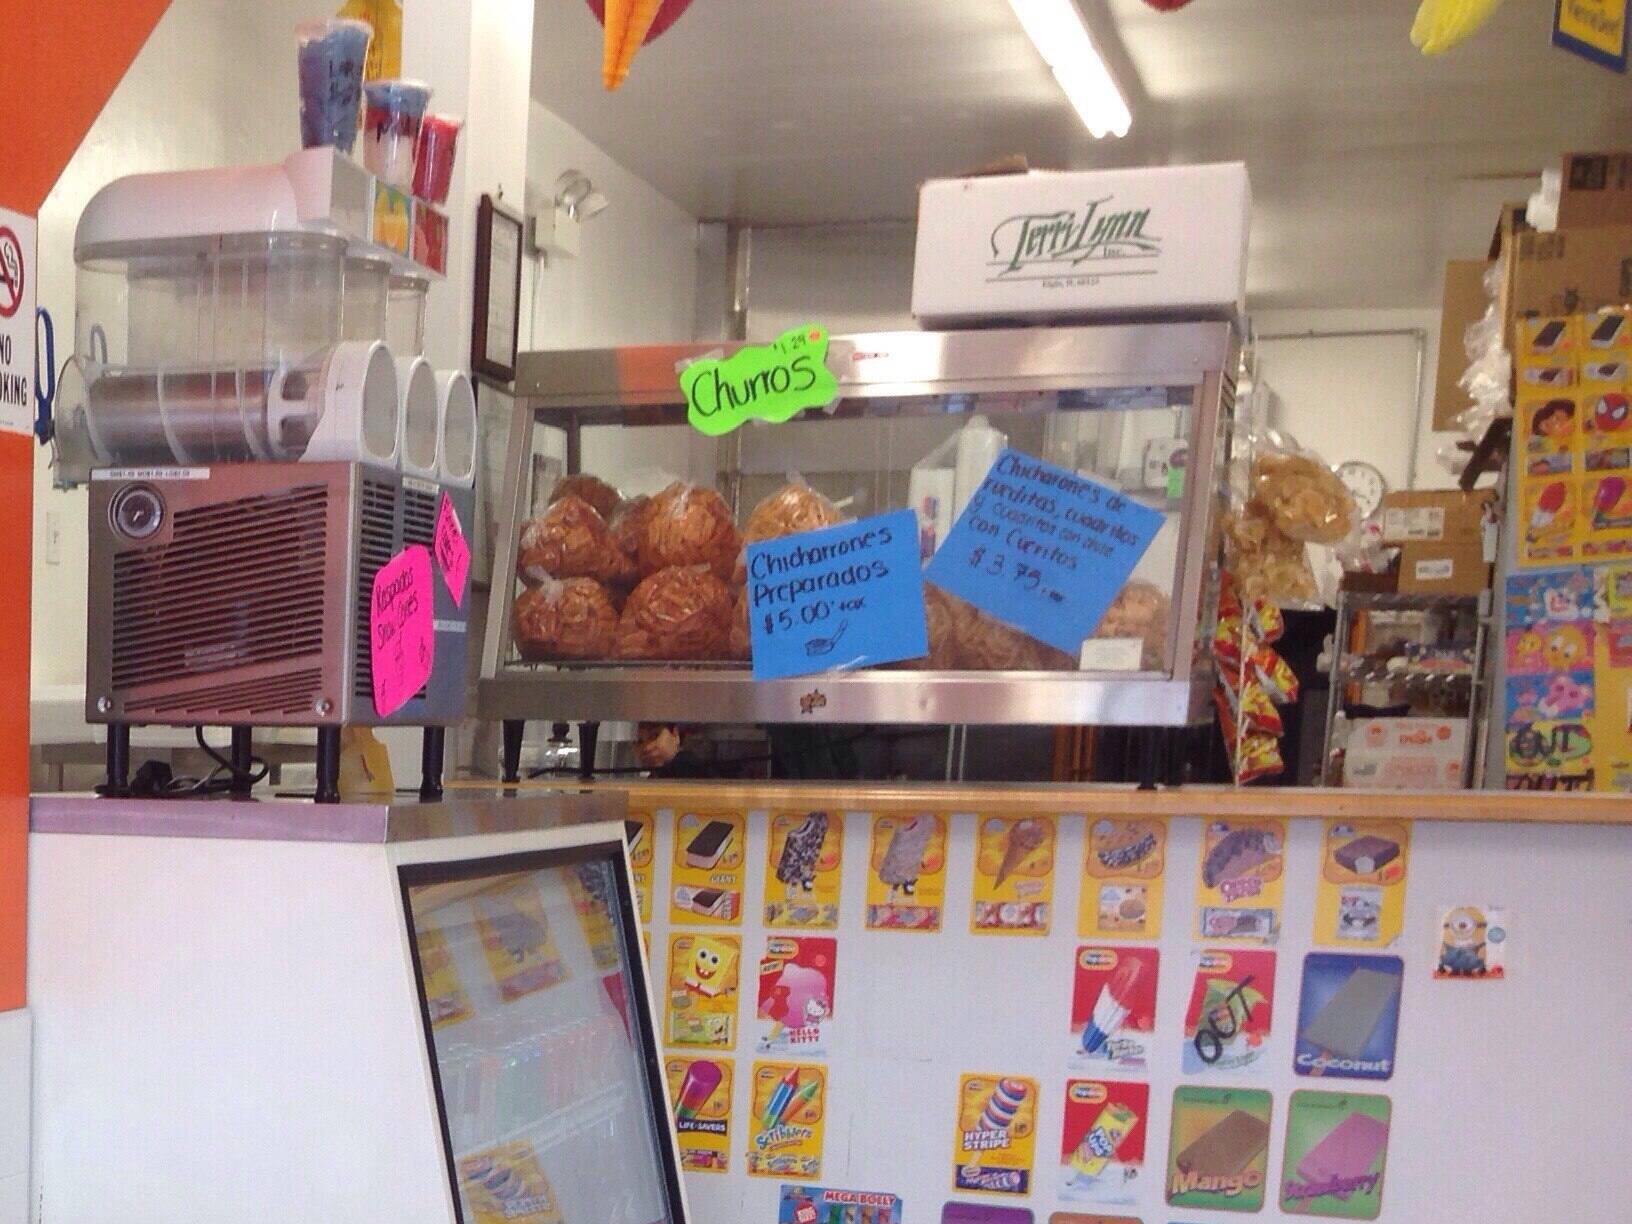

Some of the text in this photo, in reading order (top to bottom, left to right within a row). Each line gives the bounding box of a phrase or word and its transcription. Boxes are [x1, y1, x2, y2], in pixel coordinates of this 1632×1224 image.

[691, 355, 817, 417] Churros
[753, 559, 889, 608] Preparados
[1195, 974, 1255, 1065] OUT
[1297, 1053, 1392, 1074] Coconut
[962, 1138, 1010, 1151] STRIPE
[963, 1128, 1009, 1142] HYPER
[1172, 1169, 1264, 1199] Mango
